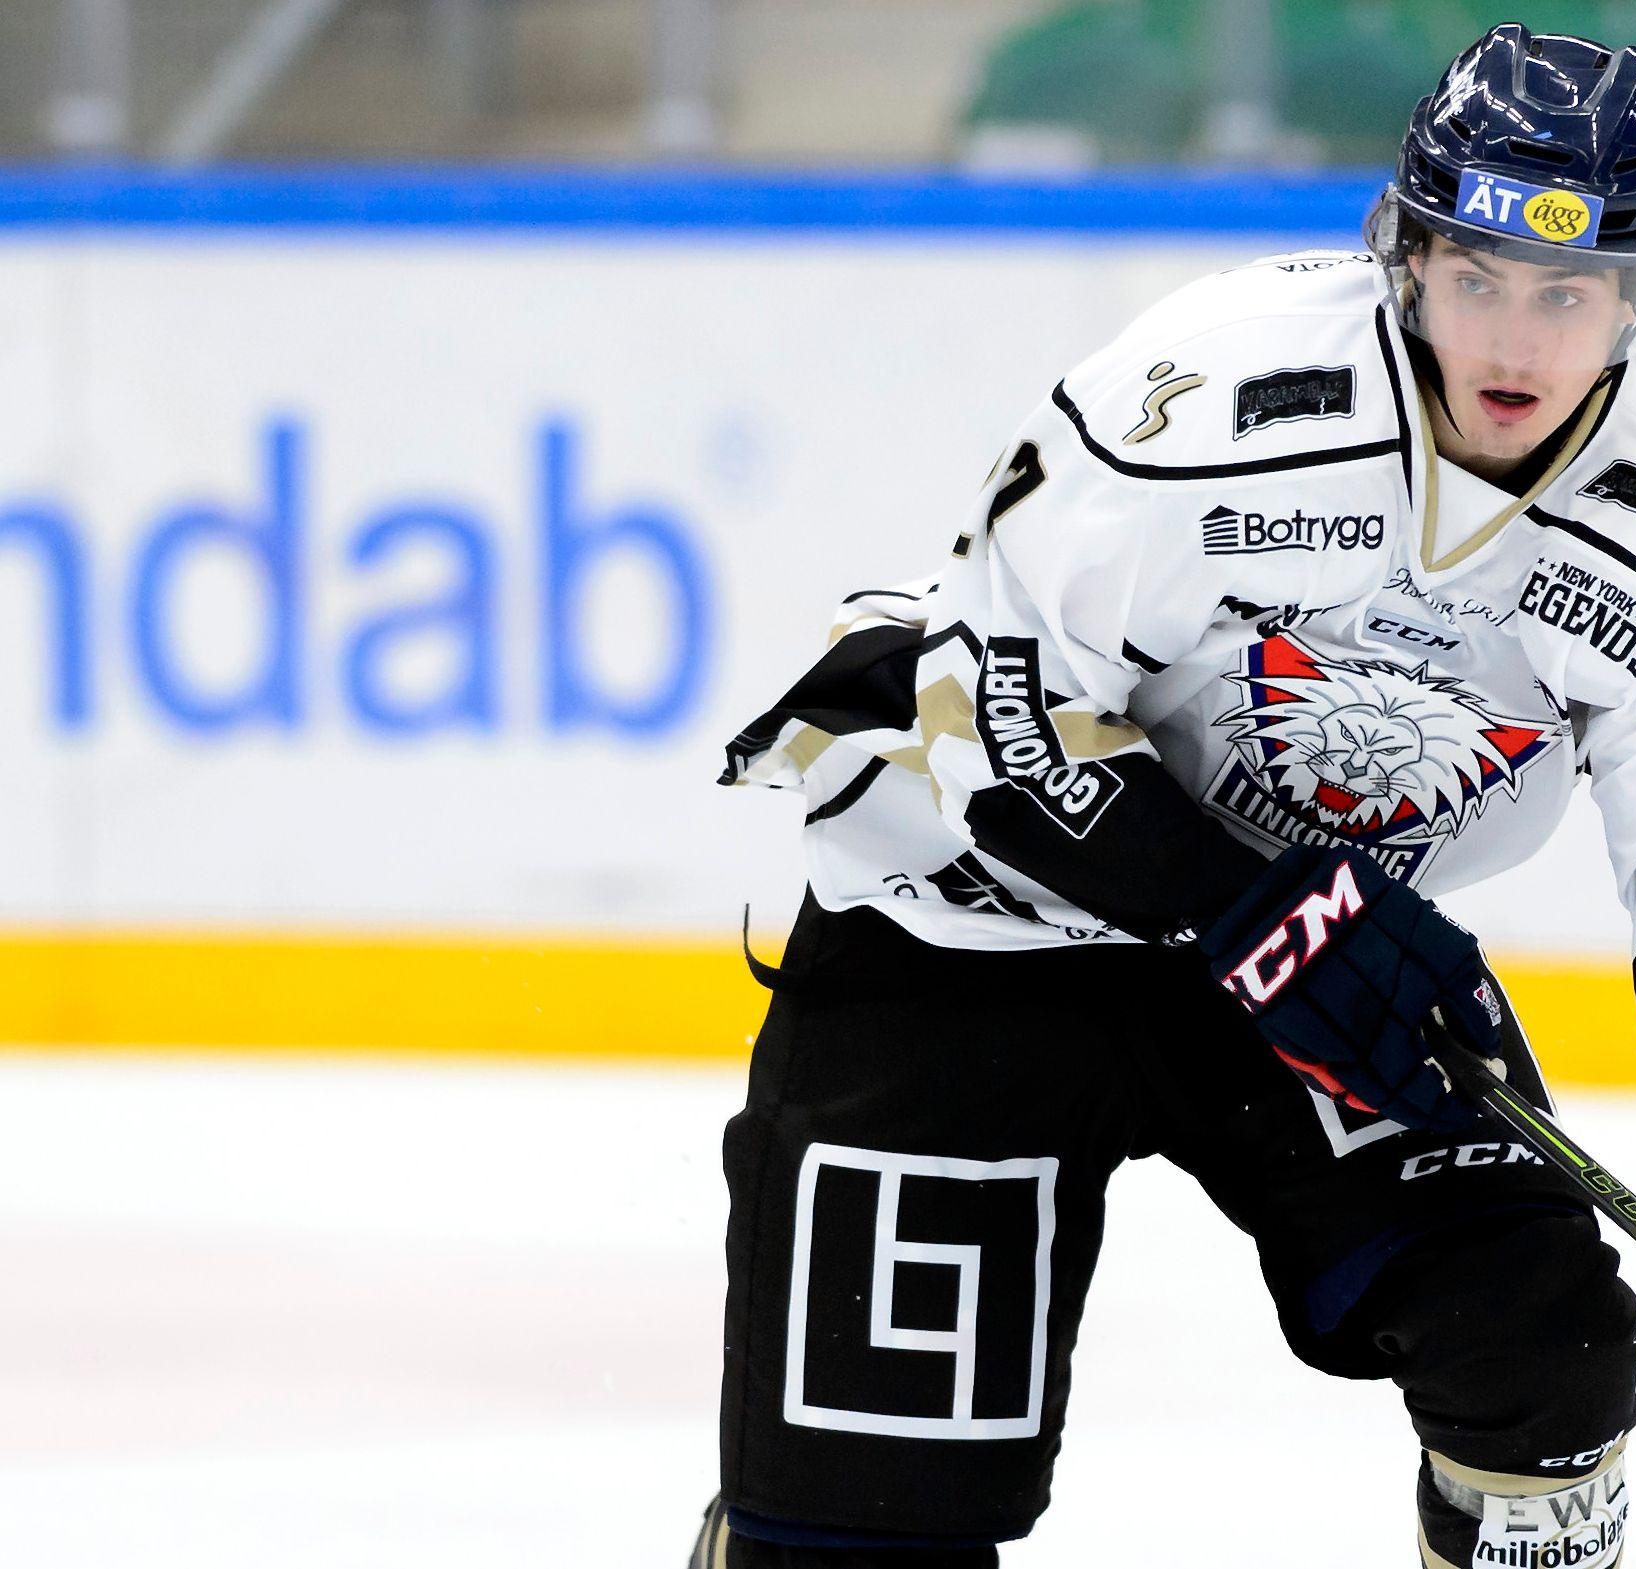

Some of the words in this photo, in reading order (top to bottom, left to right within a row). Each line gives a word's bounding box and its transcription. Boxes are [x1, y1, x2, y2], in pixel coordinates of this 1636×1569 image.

[1463, 175, 1523, 224] ÄT
[1532, 197, 1585, 236] ägg
[1244, 509, 1384, 551] Botrygg
[1555, 561, 1598, 592] NEW
[1367, 615, 1461, 651] CCM
[1222, 860, 1364, 1013] CM
[1400, 1142, 1545, 1181] CCM
